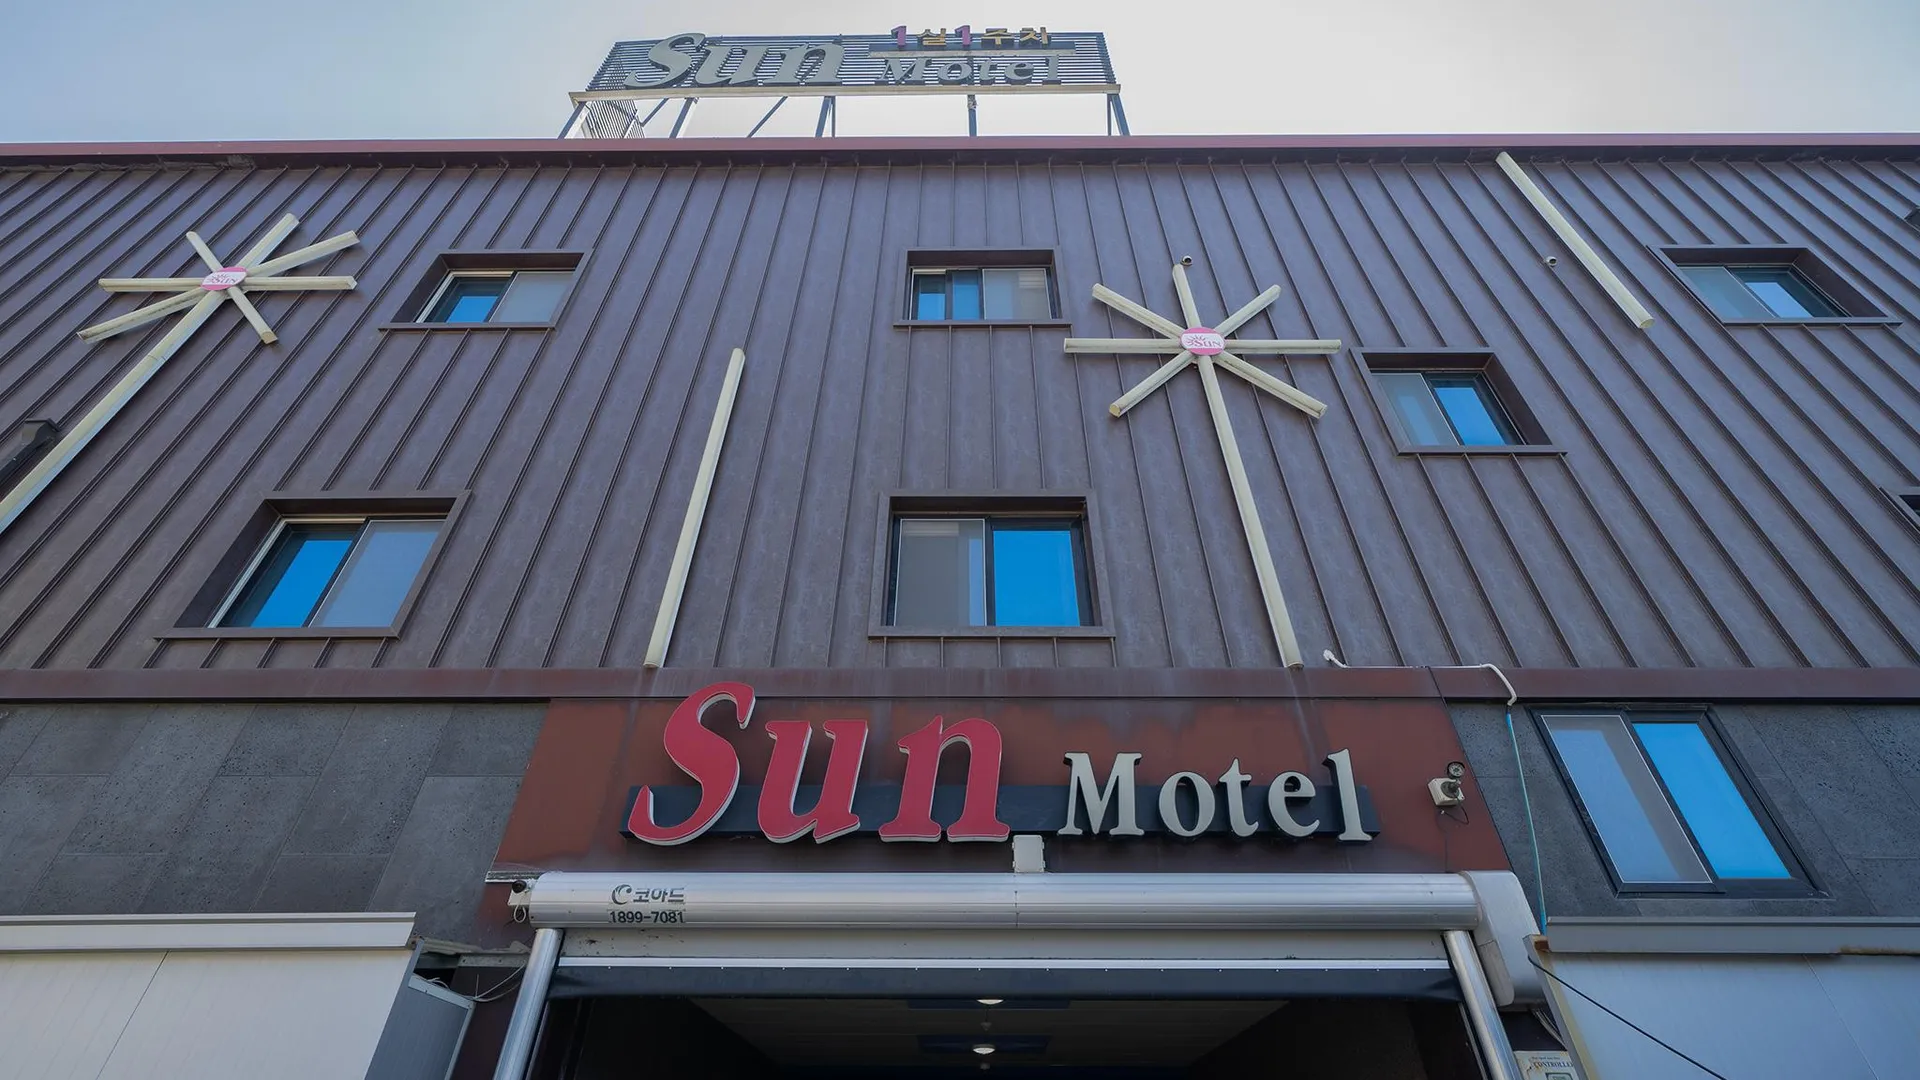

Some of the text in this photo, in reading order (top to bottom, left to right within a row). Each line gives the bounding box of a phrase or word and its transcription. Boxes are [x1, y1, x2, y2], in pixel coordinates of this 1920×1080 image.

[890, 25, 1050, 47] 1실1주차
[623, 32, 1060, 88] Sun Motel
[627, 681, 1374, 846] Sun Motel
[632, 887, 685, 903] 코아드
[609, 910, 685, 924] 1899-7081
